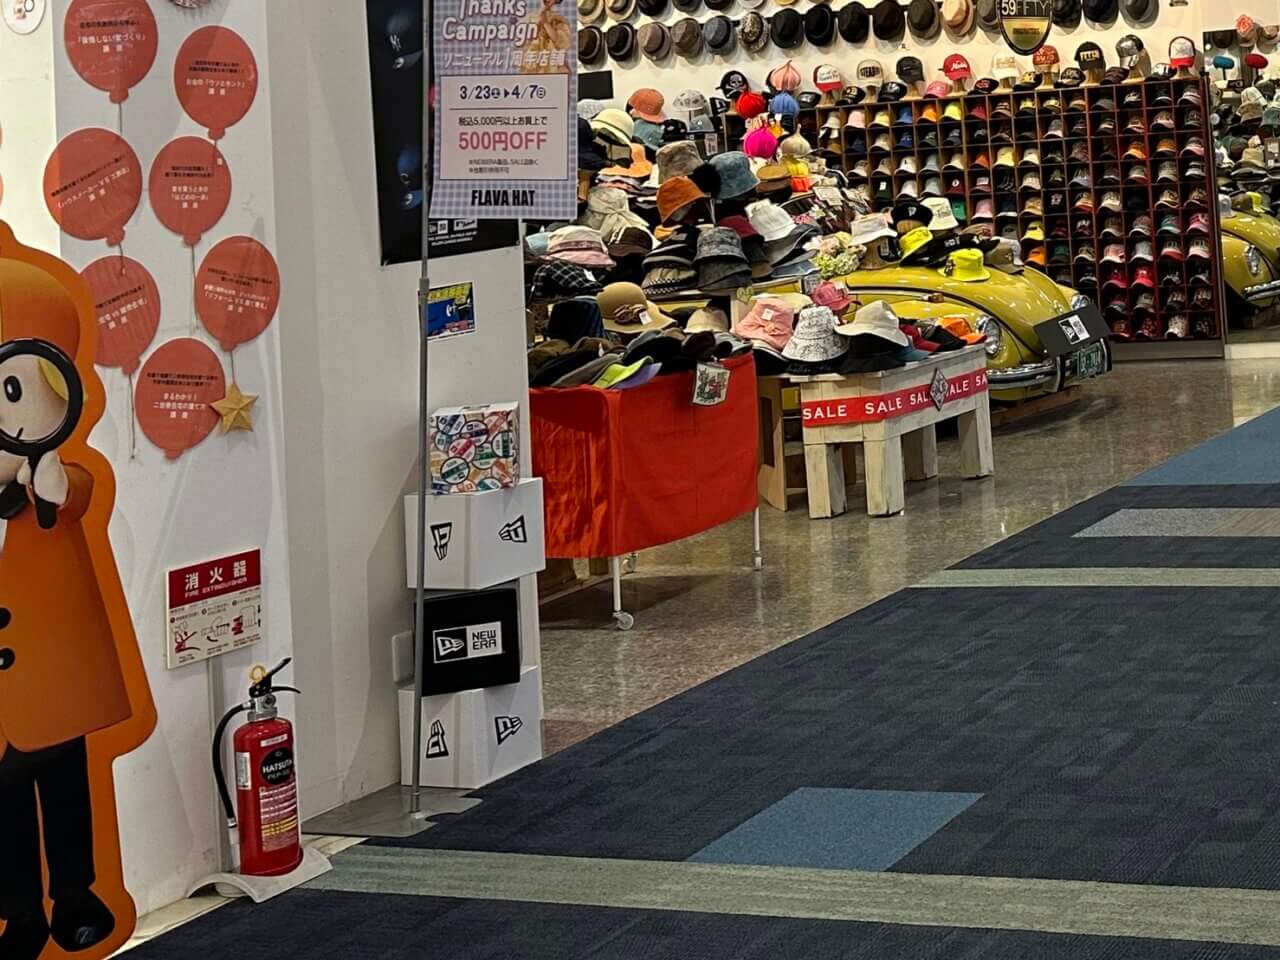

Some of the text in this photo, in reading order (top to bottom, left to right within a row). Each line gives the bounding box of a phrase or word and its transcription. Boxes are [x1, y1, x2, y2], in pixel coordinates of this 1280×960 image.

[443, 17, 538, 47] Campaign
[458, 130, 548, 152] 500円OFF
[471, 189, 536, 207] FLAVA HAT
[803, 404, 848, 420] SALE
[864, 399, 903, 415] SALE
[909, 392, 930, 406] SAL
[946, 379, 969, 399] ALE
[184, 560, 247, 591] 消火器
[472, 629, 497, 641] NEW
[472, 638, 497, 650] ERA
